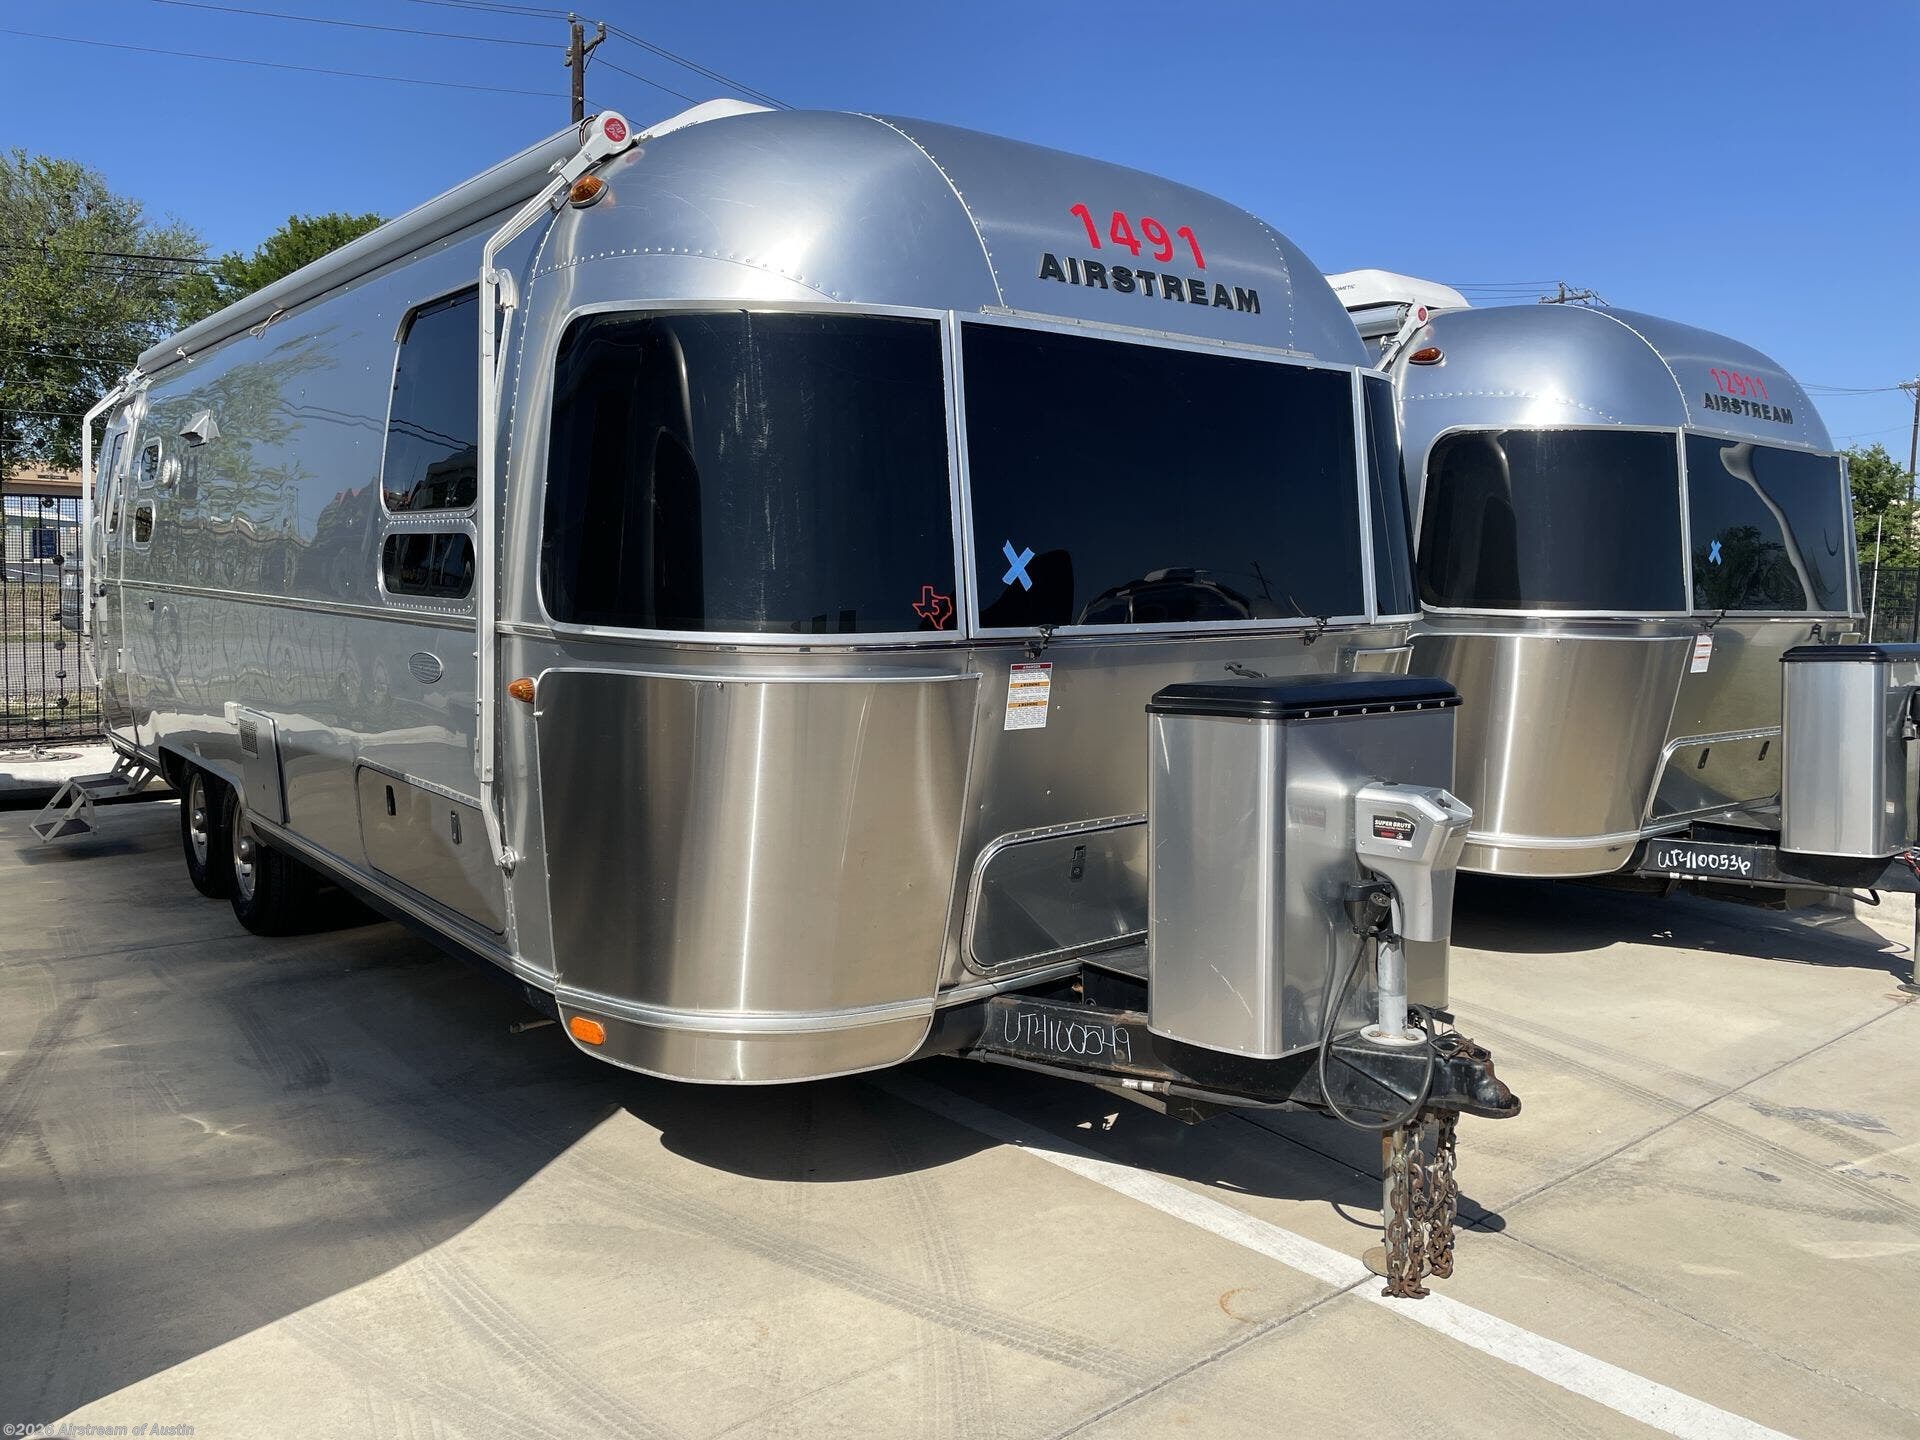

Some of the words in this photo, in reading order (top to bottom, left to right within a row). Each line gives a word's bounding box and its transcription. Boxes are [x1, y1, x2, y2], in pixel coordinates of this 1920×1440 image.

[1069, 203, 1206, 270] 1491
[1038, 253, 1261, 314] AIRSTREAM
[1709, 368, 1769, 400] 12911
[1703, 393, 1793, 424] AIRSTREAM
[932, 600, 940, 615] 5
[1004, 1010, 1132, 1063] UT4100549
